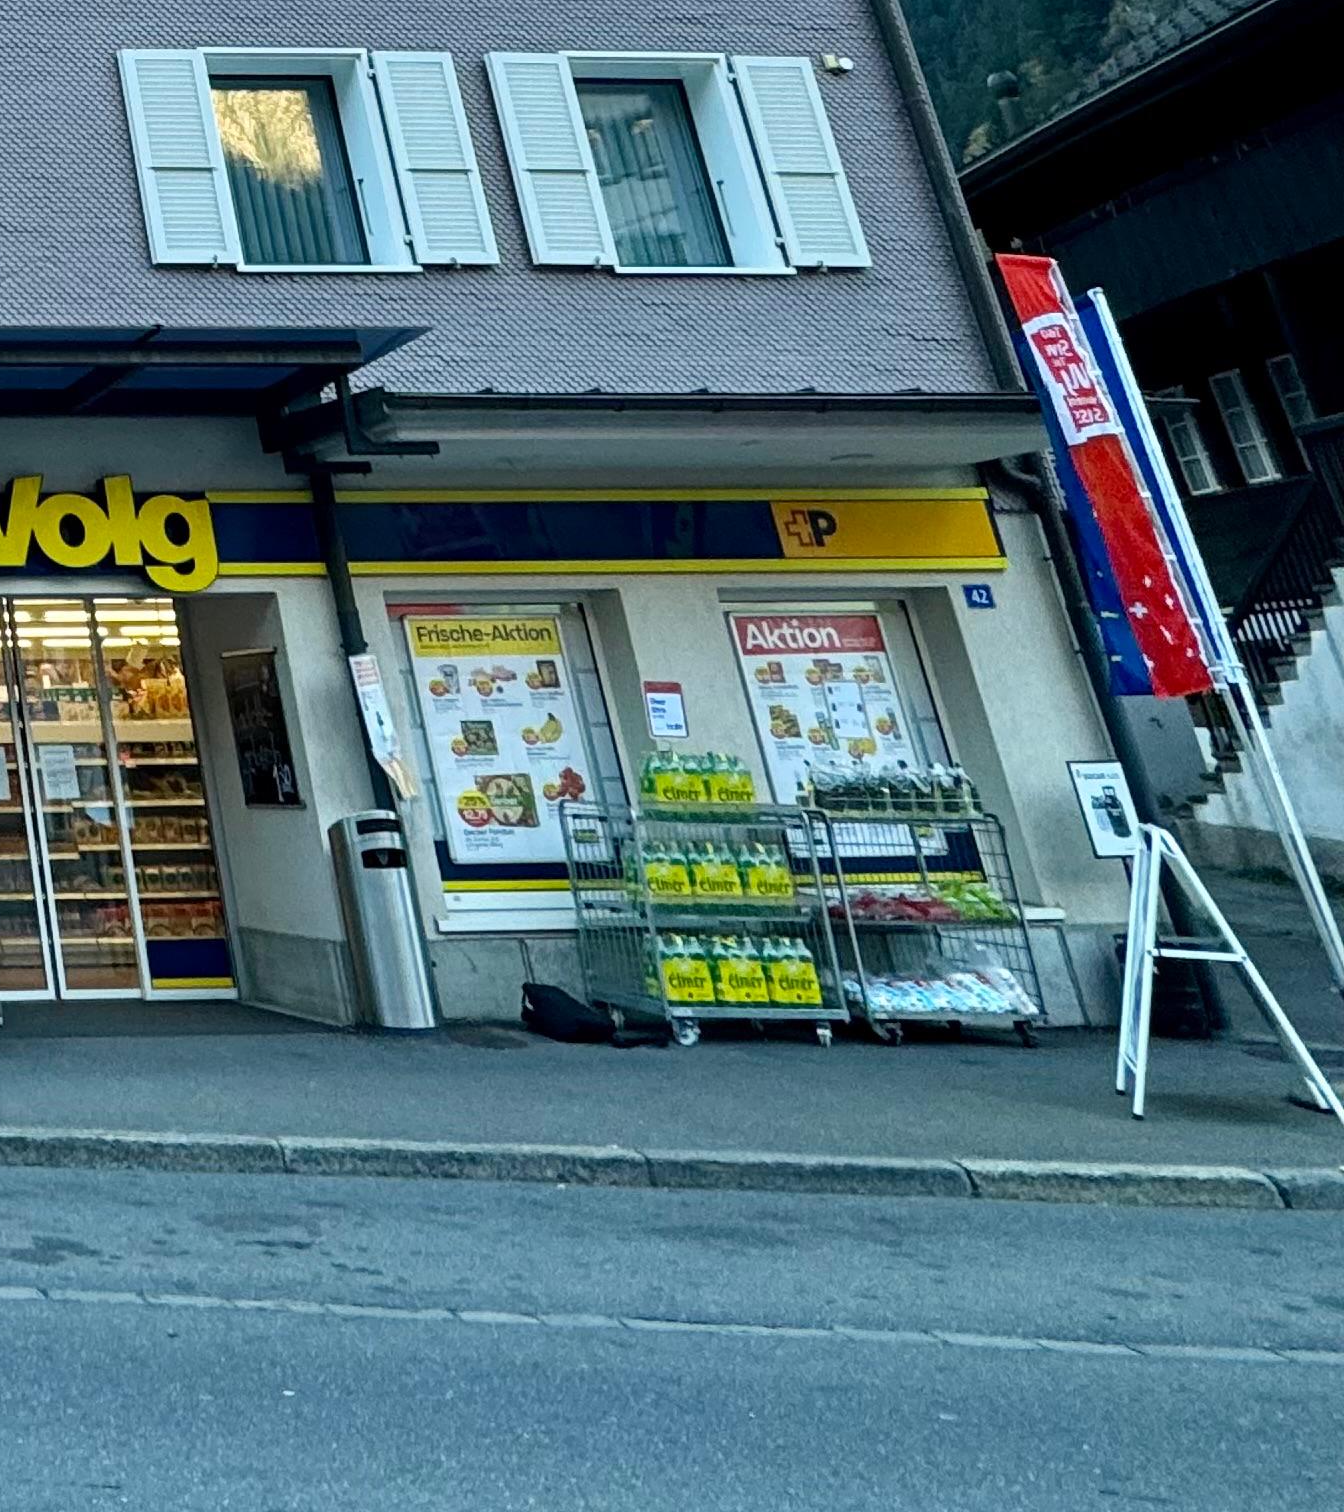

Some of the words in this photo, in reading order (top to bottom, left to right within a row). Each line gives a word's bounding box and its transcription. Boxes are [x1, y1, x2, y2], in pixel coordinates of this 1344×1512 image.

[808, 510, 838, 547] P
[971, 590, 990, 604] 42
[416, 624, 552, 642] Frische-Aktion
[746, 618, 842, 650] Aktion
